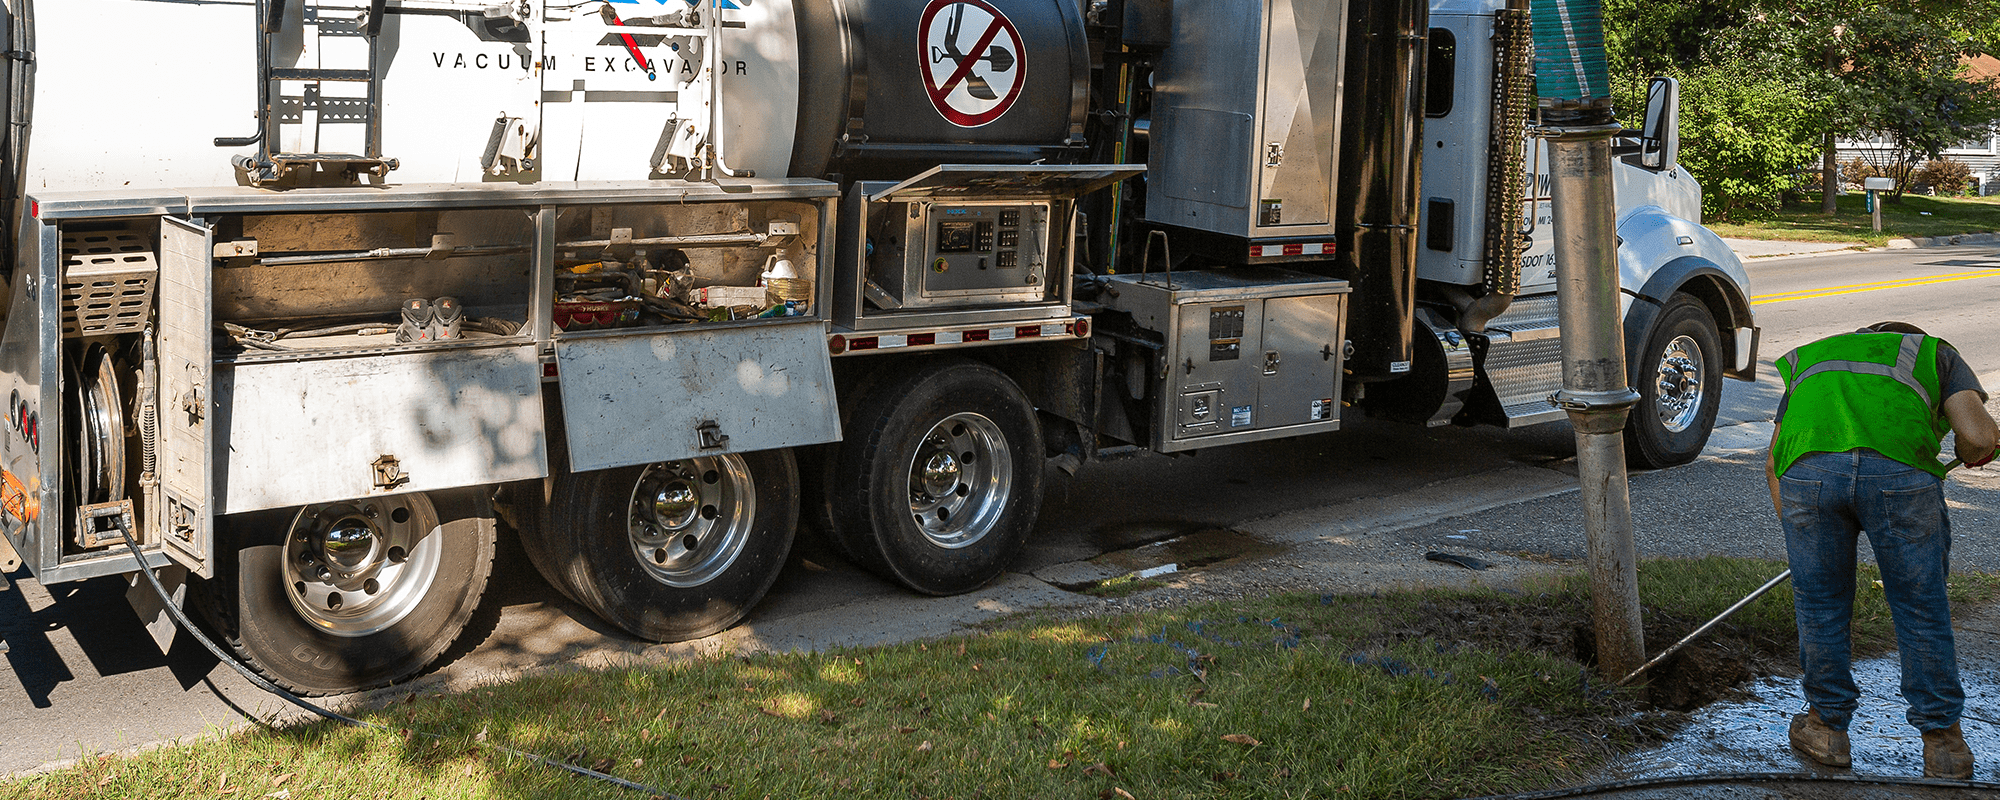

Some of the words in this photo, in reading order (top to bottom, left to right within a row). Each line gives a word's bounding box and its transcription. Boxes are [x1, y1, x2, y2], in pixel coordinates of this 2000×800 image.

[432, 51, 556, 71] VACUUM
[584, 56, 747, 76] EXCAVAR
[1520, 254, 1544, 268] SDOT
